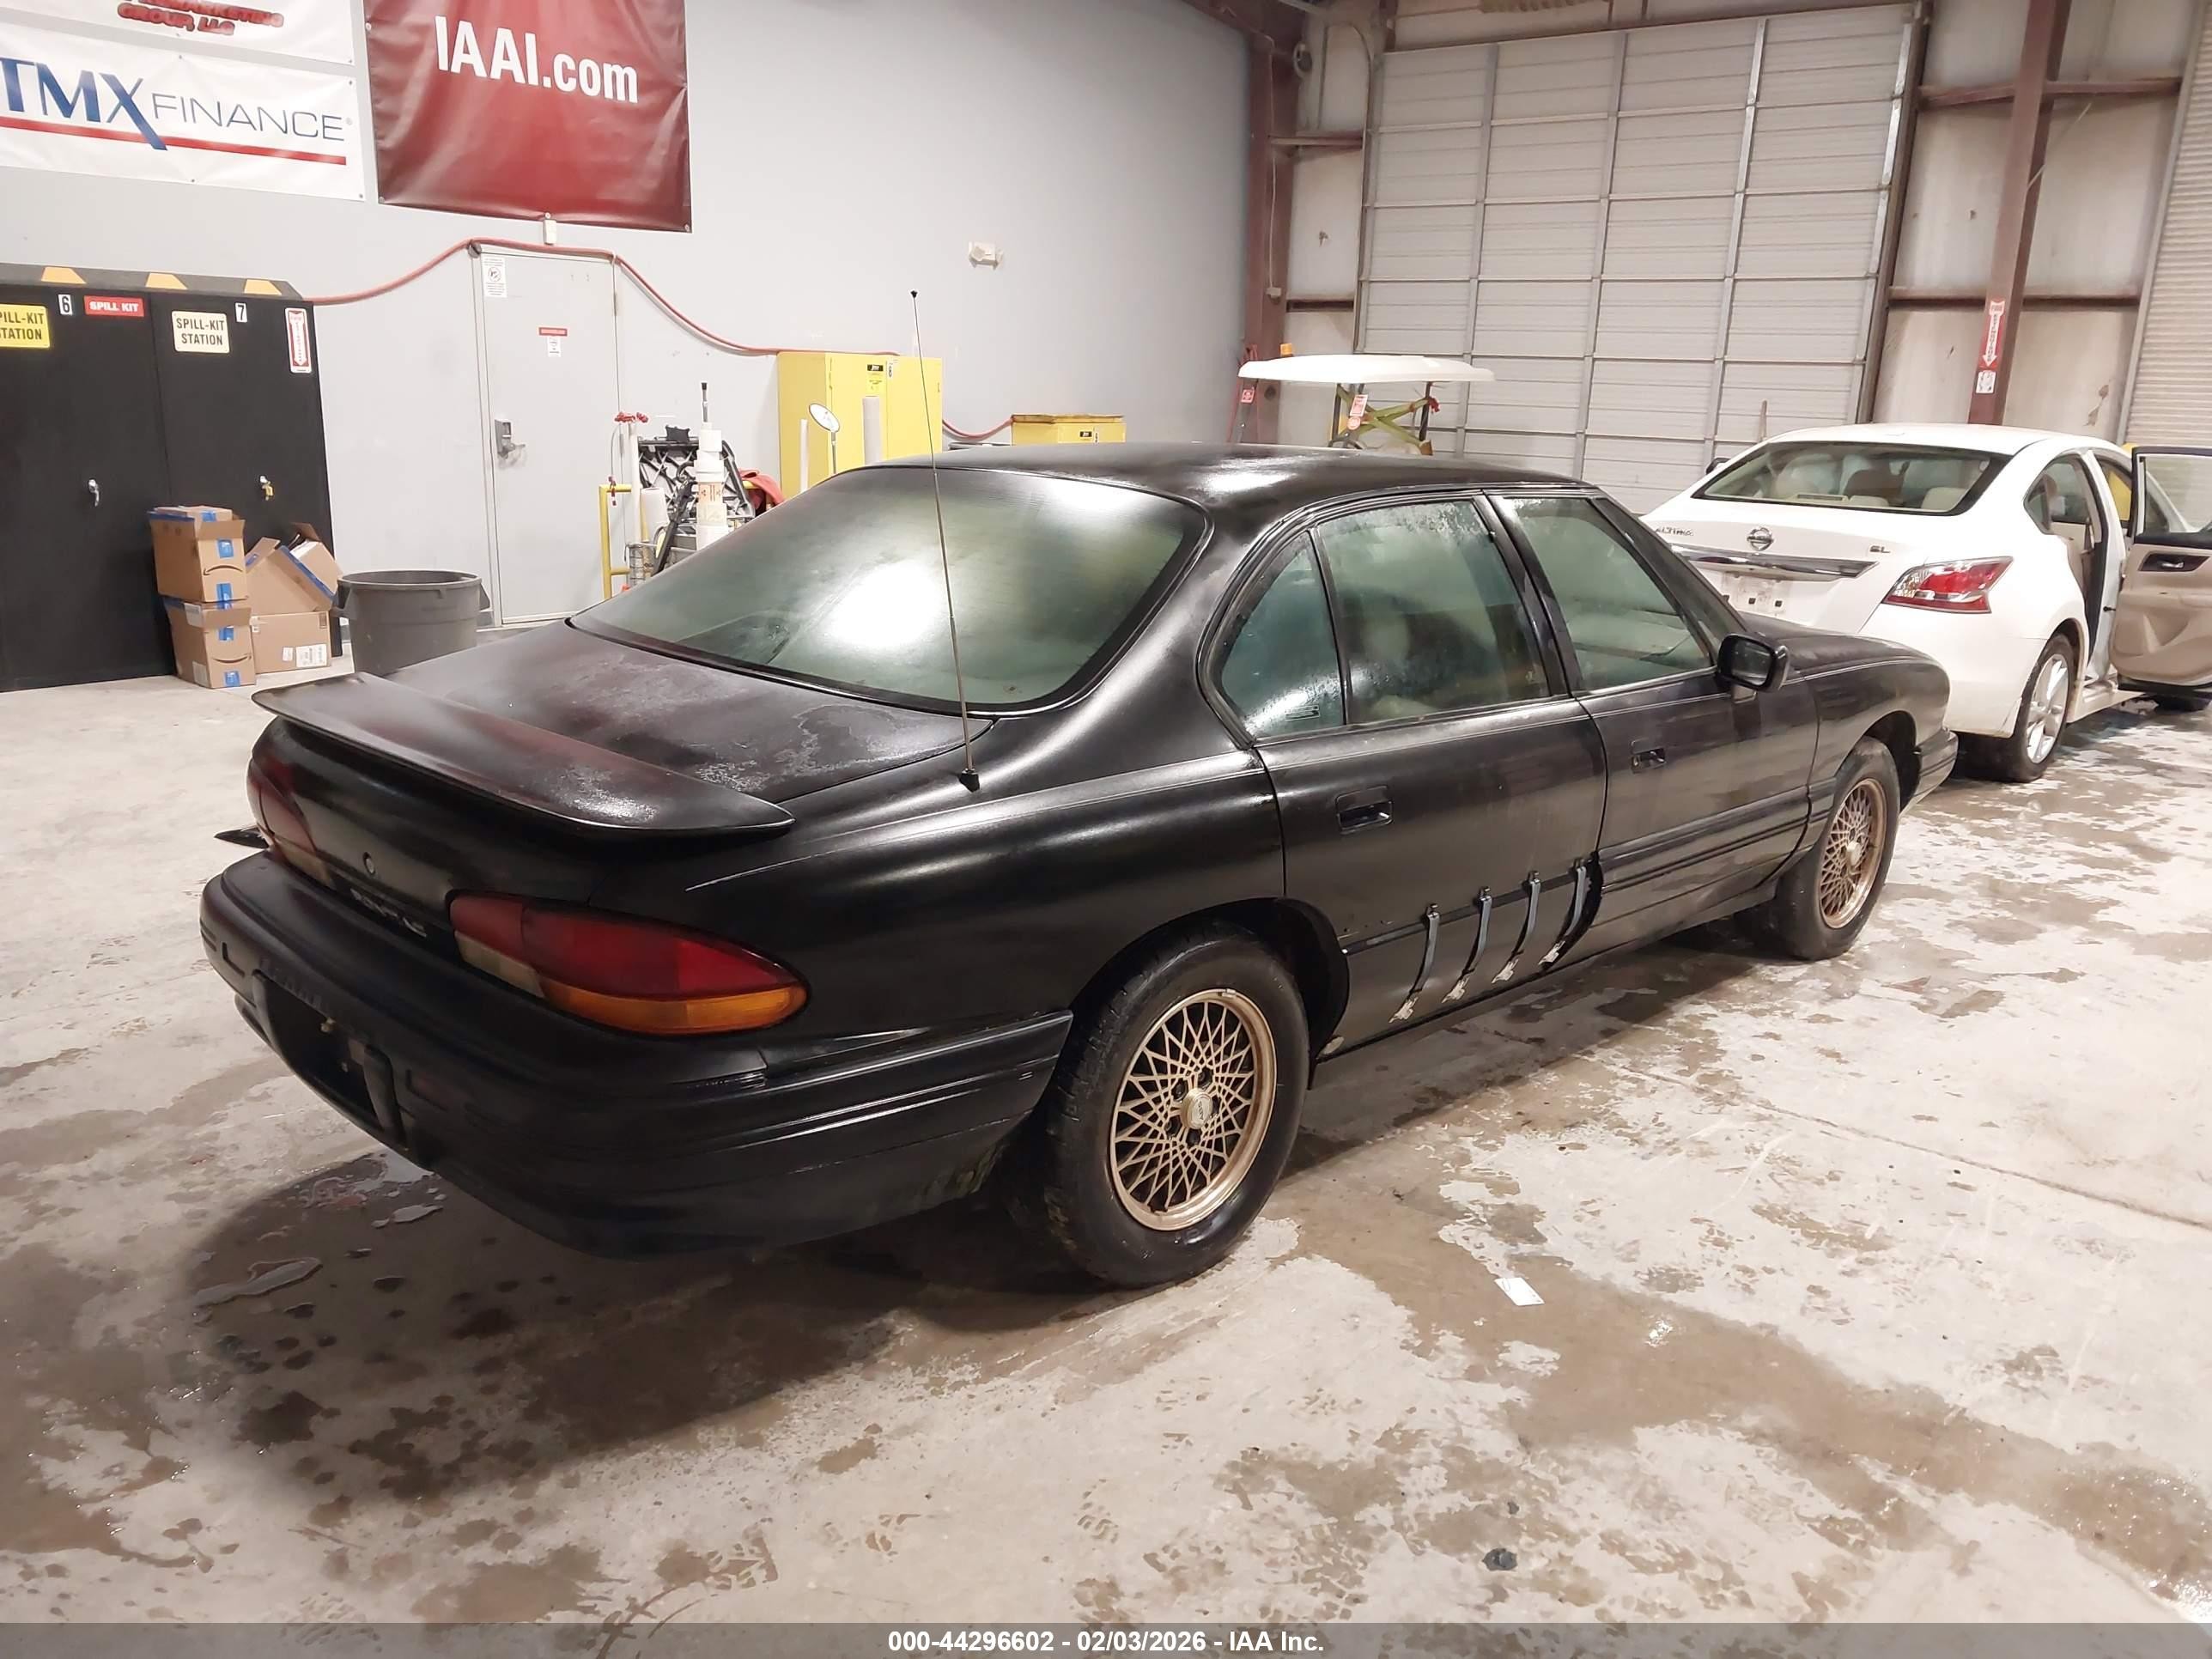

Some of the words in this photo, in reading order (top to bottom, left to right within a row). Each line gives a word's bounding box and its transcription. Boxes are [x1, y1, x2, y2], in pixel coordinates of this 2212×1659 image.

[434, 15, 638, 103] IAAI.com
[151, 93, 344, 142] FINANCE
[62, 296, 70, 313] 6
[89, 301, 118, 311] SPILL
[122, 303, 139, 312] KIT
[0, 312, 44, 325] PILL-KIT
[238, 305, 245, 321] 7
[176, 318, 224, 331] SPILL-KIT
[0, 327, 42, 340] TATION
[181, 333, 223, 346] STATION
